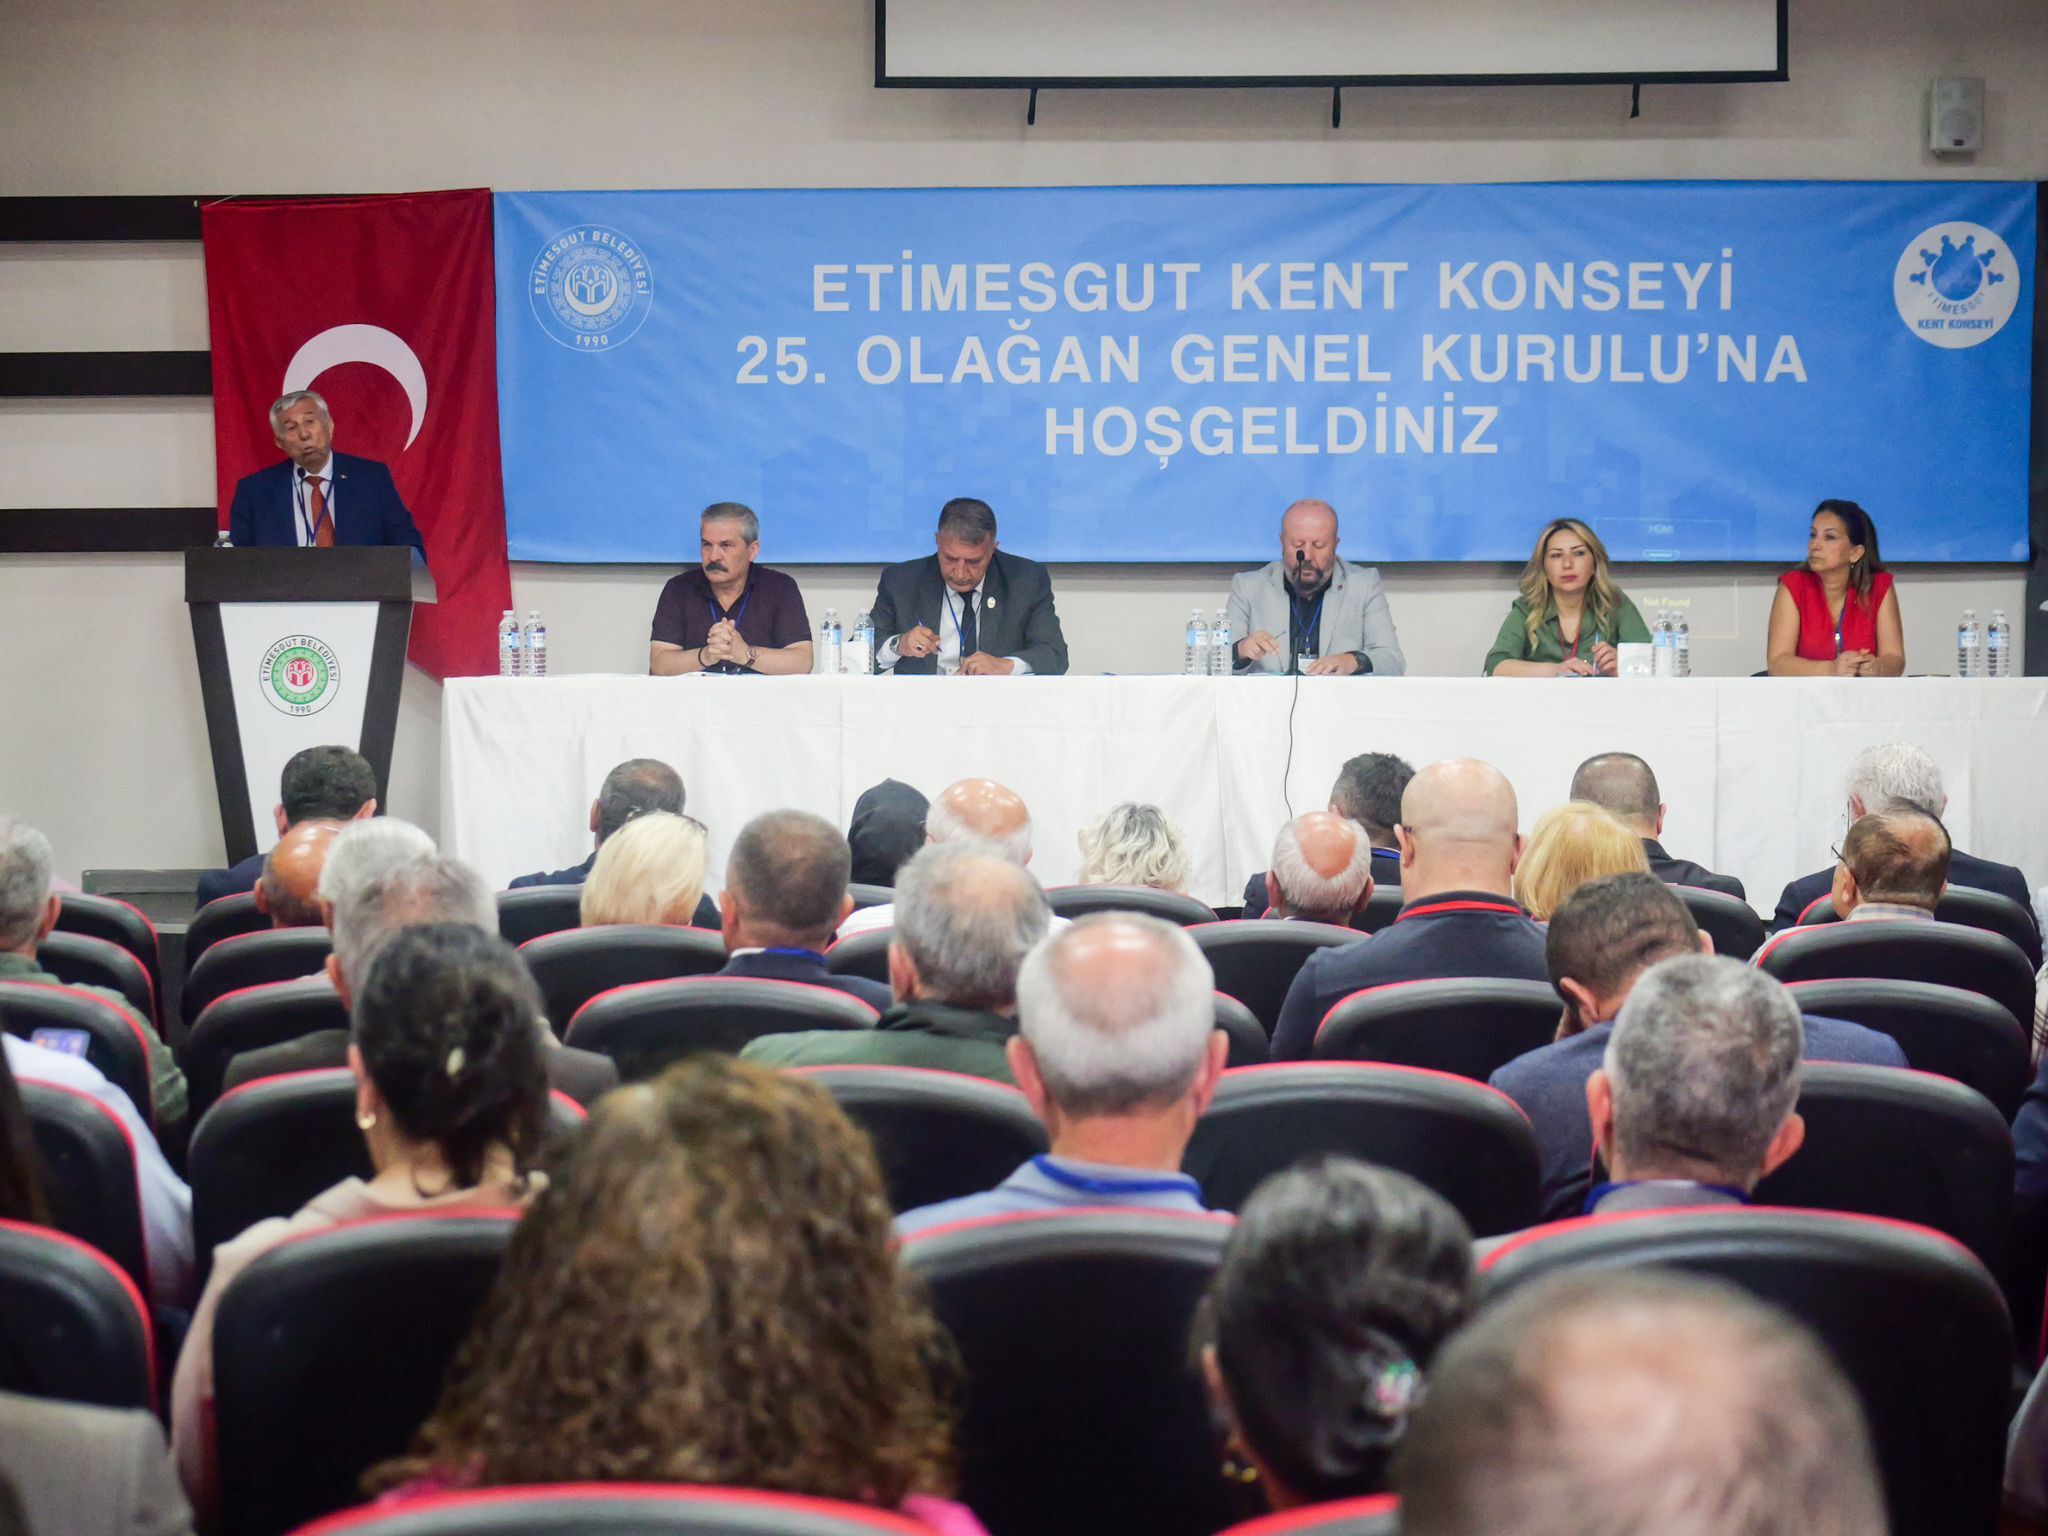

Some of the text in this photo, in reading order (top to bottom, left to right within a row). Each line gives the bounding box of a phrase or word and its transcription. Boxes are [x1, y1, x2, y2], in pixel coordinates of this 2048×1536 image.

[534, 230, 650, 295] ETİMESGUT BELEDİYESİ
[813, 248, 1733, 313] ETİMESGUT KENT KONSEYİ
[576, 335, 608, 345] 1990
[1918, 317, 1994, 329] KENT KONSEYİ
[736, 335, 826, 385] 25.
[857, 318, 1140, 385] OLAĞAN
[1170, 333, 1393, 385] GENEL
[1045, 391, 1499, 470] HOŞGELDİNİZ
[263, 638, 337, 682] ETİMESGUT BELEDİYESİ
[290, 705, 312, 713] 1990
